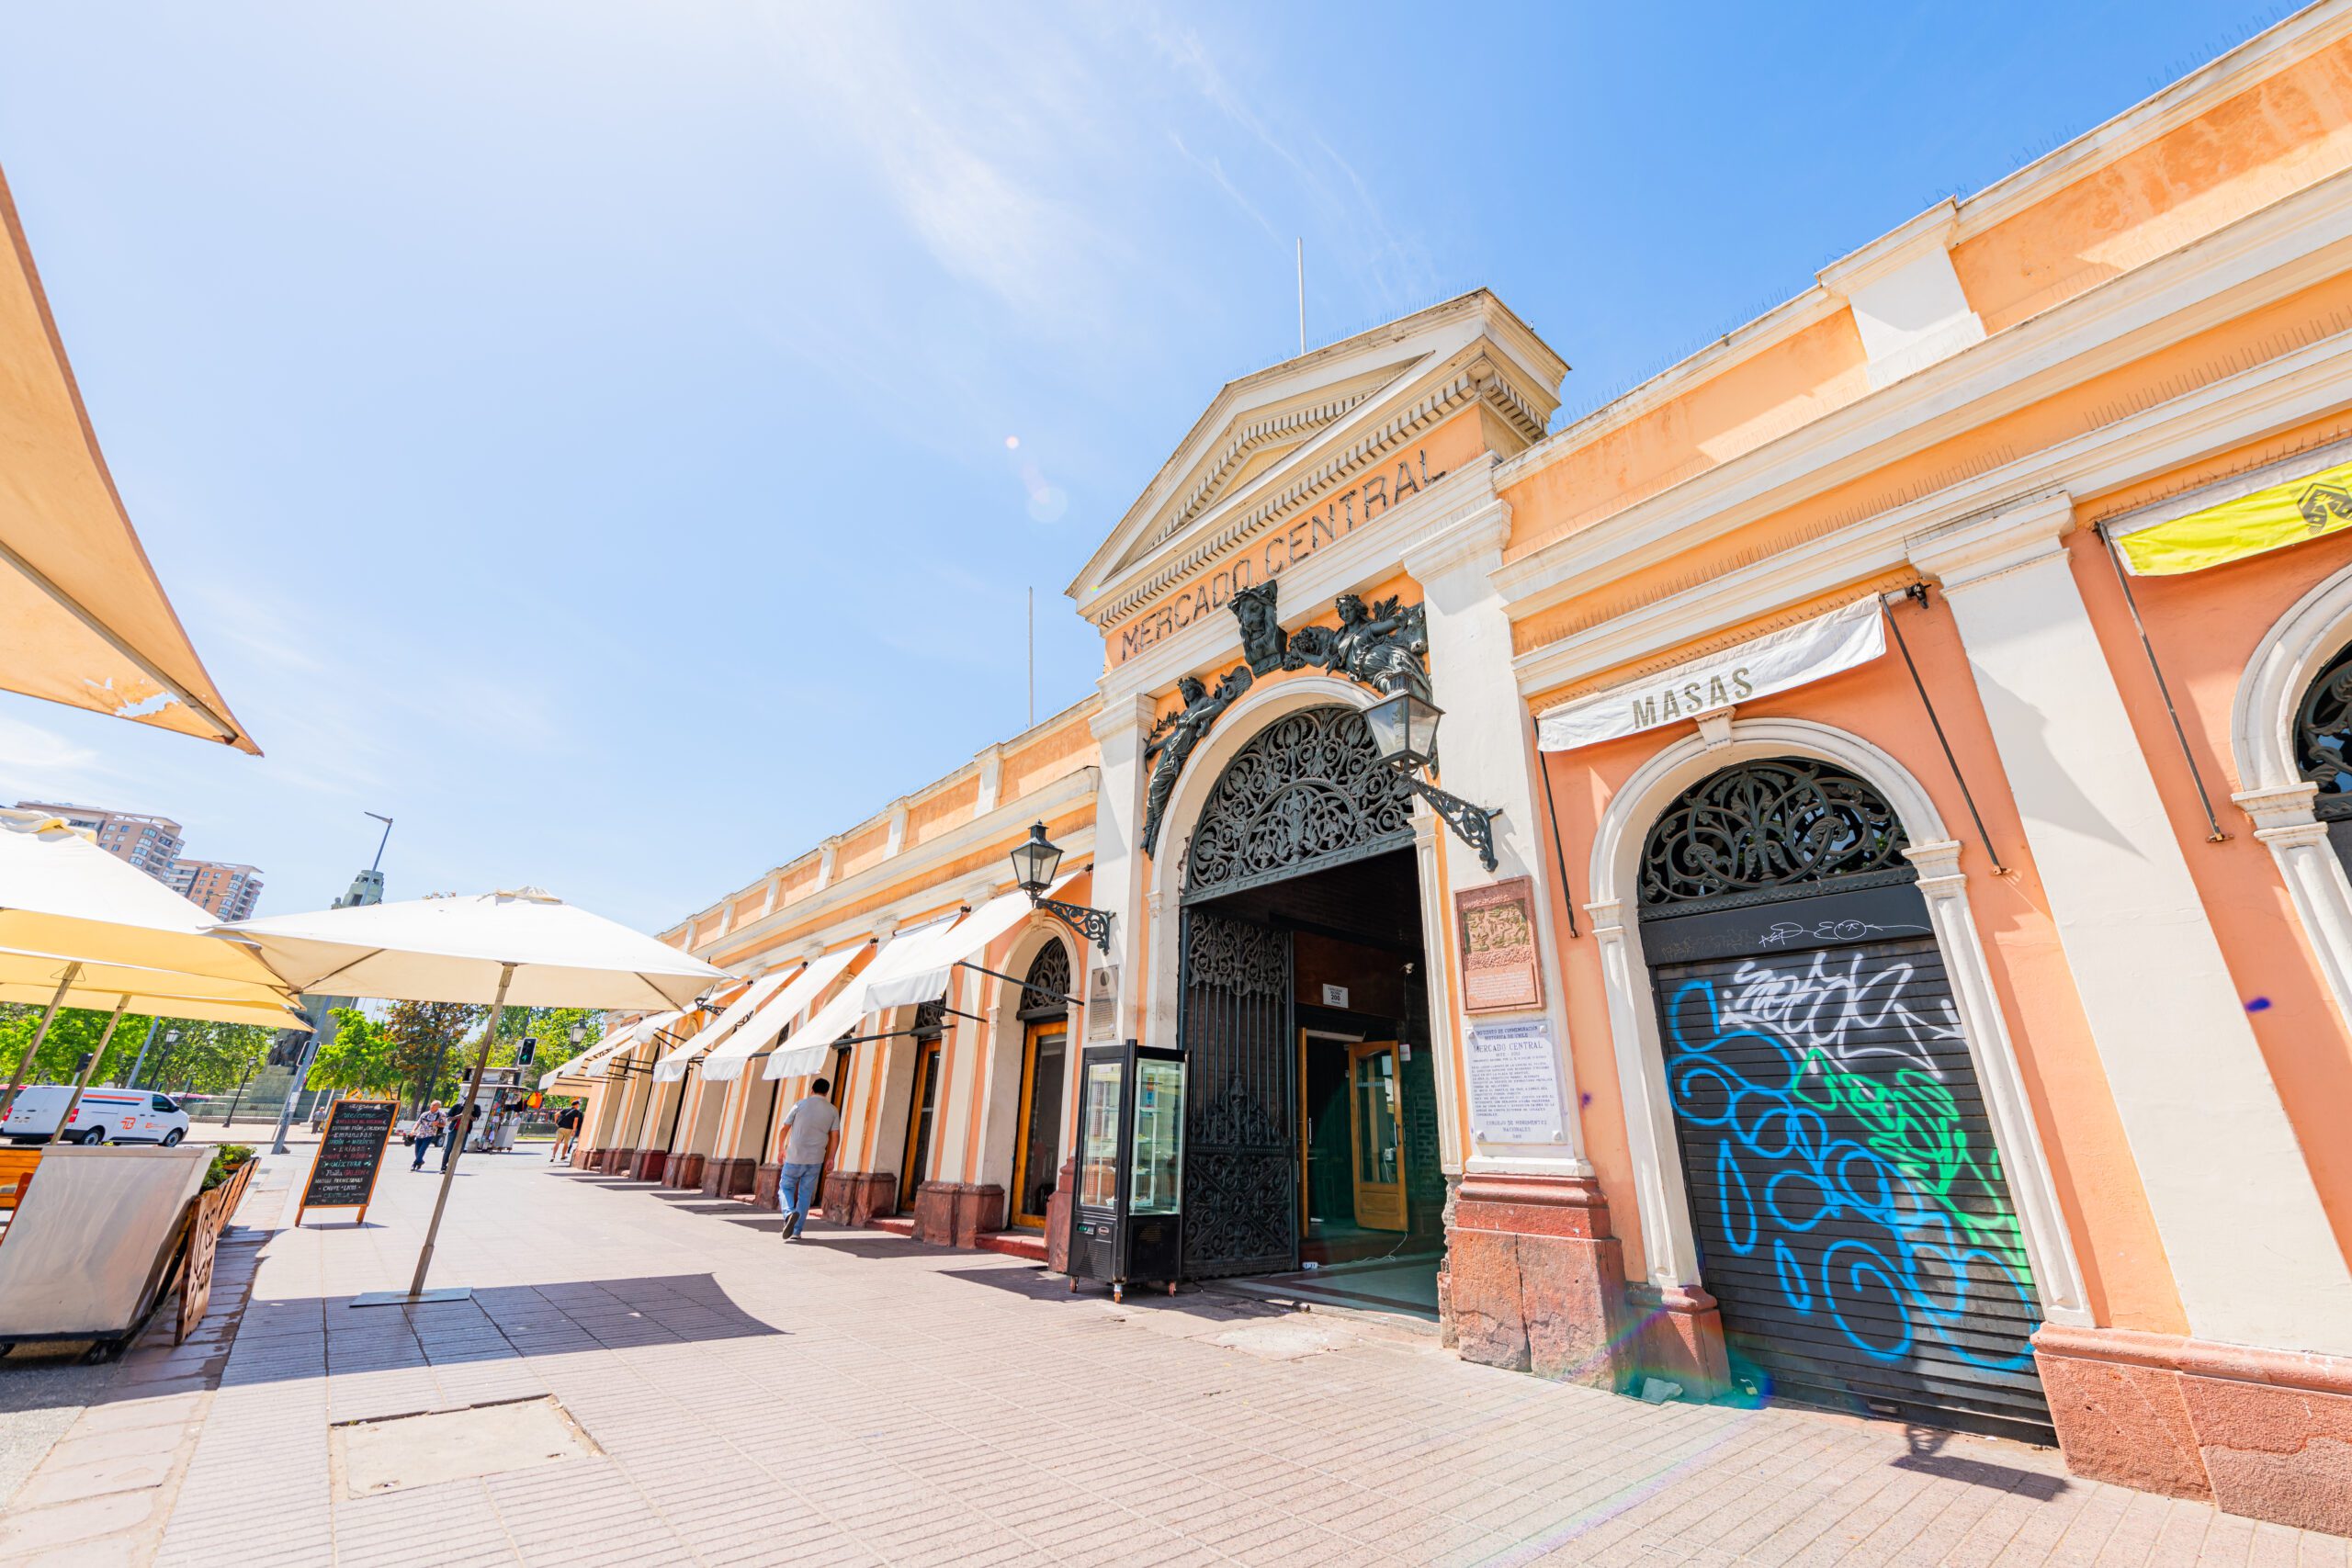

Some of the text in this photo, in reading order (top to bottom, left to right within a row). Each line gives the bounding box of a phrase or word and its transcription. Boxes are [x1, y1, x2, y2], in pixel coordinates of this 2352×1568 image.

[1122, 448, 1447, 660] MERCADO CENTRAL
[1633, 667, 1753, 729] MASAS
[1473, 1041, 1544, 1053] MERCADO CENTRAL
